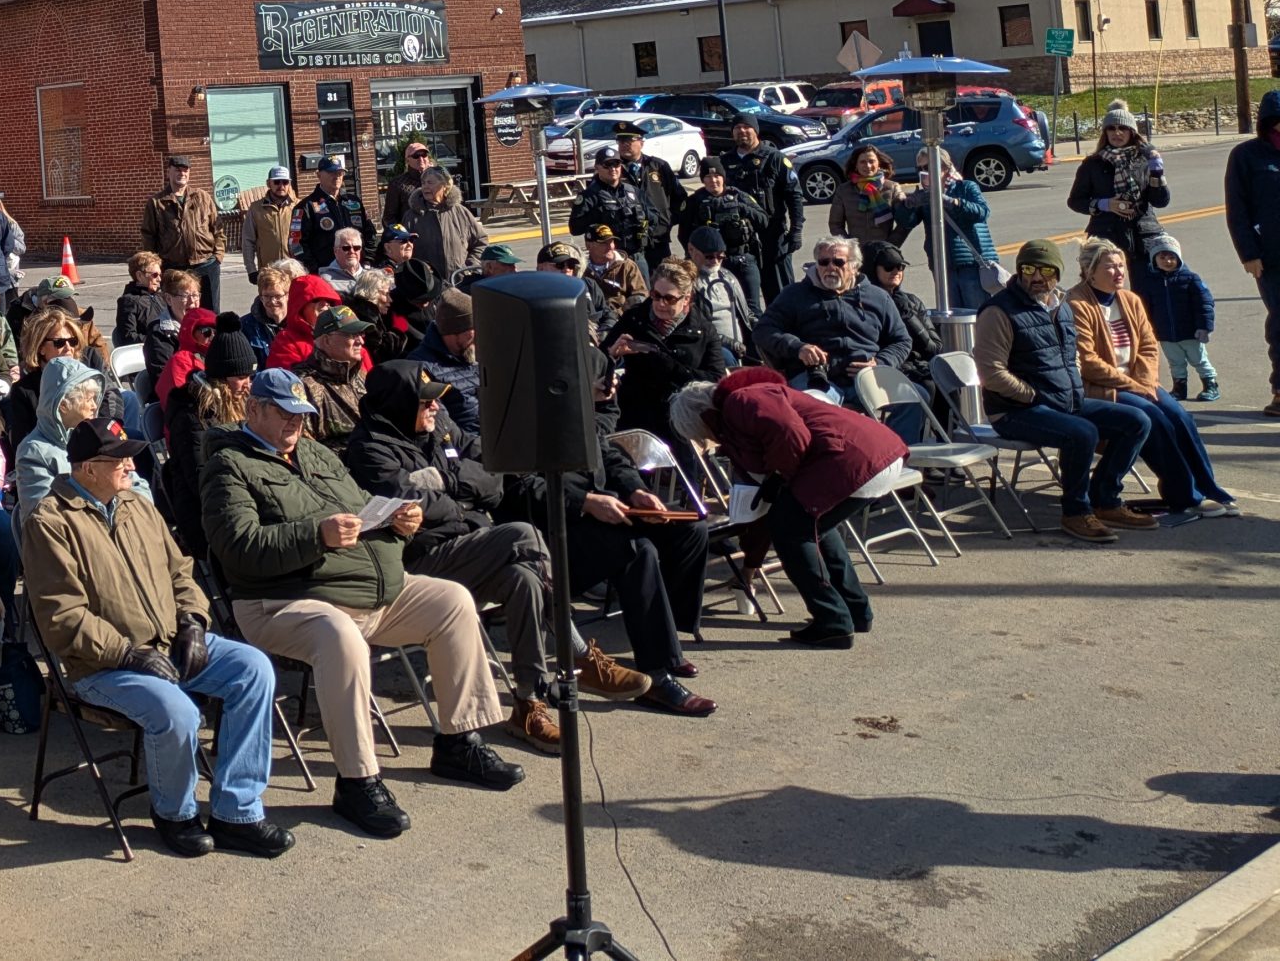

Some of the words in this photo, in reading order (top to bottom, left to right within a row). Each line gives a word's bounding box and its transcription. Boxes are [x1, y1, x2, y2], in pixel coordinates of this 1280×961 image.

[297, 5, 337, 17] FARMER
[344, 1, 397, 9] DISTILLER
[404, 4, 436, 16] OWNED
[259, 4, 445, 66] REGENERATION
[297, 53, 380, 67] DISTILLING
[326, 92, 338, 102] 31
[405, 112, 425, 122] GIFT
